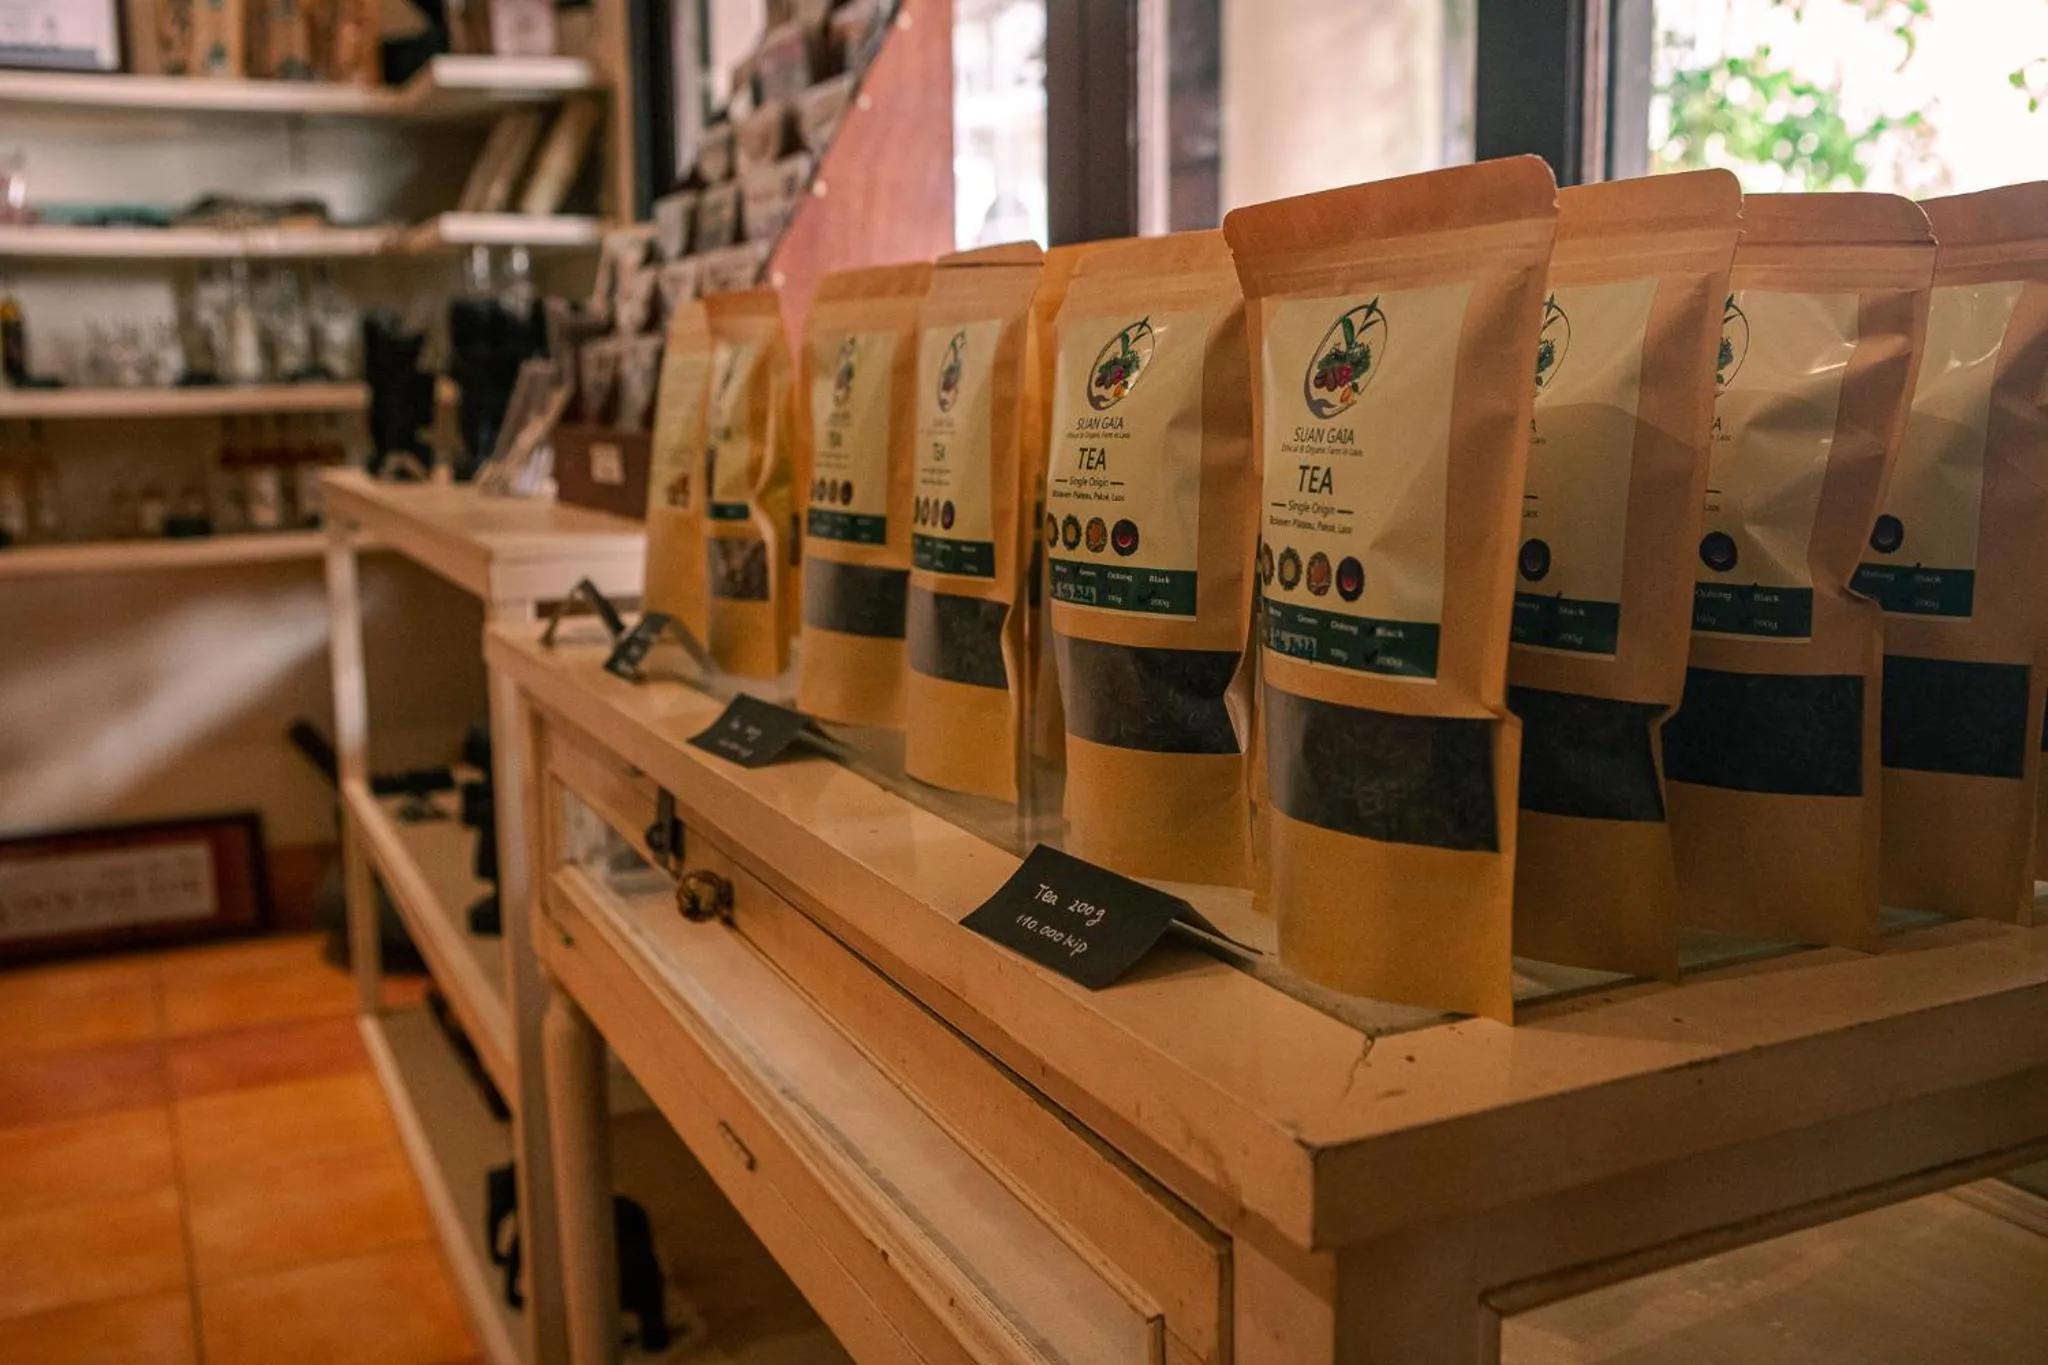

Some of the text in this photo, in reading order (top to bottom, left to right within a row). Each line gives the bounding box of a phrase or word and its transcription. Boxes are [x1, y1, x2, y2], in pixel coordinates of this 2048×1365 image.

[1293, 427, 1354, 445] SUAN GAIA
[1078, 447, 1106, 471] TEA
[1299, 465, 1333, 495] TEA
[1288, 500, 1336, 518] Single Origin
[1753, 593, 1779, 602] Black
[1375, 627, 1404, 638] Black
[1034, 883, 1107, 927] Tea 200g
